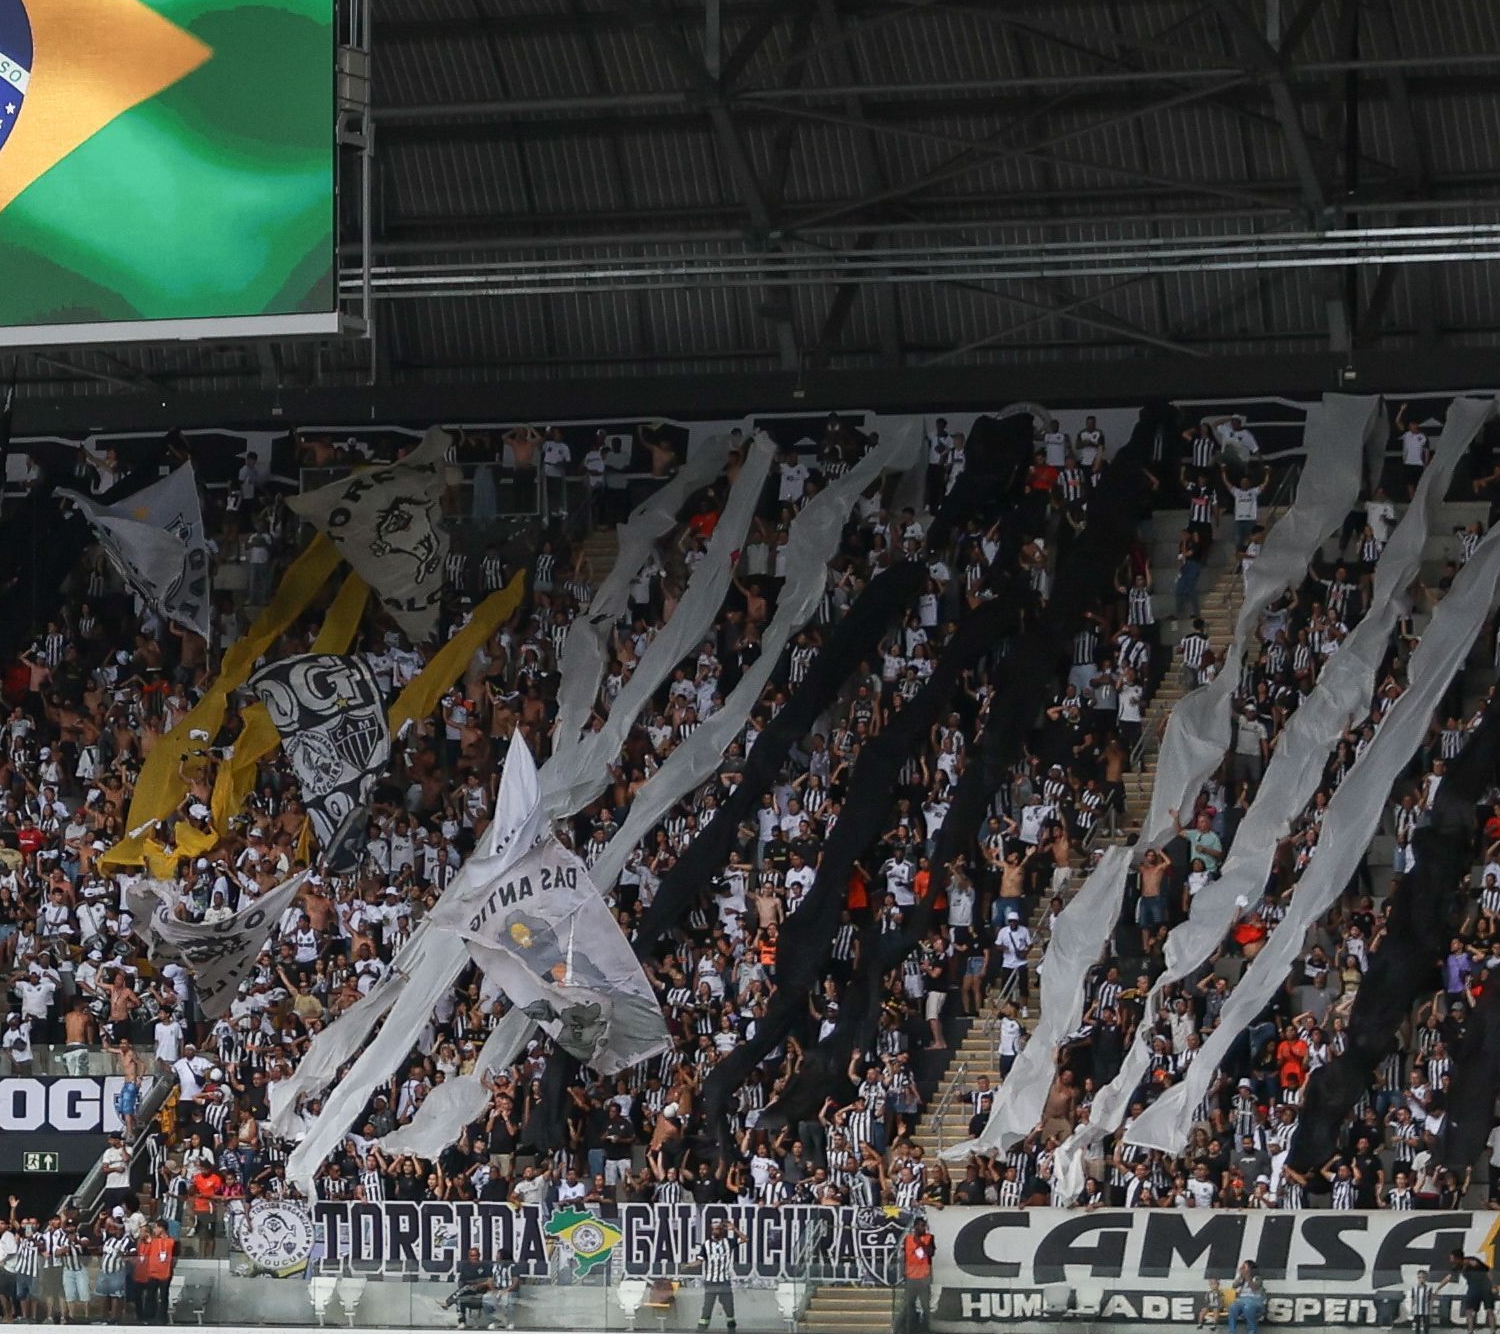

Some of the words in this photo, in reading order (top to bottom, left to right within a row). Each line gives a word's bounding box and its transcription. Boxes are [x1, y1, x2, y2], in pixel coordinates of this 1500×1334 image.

[336, 718, 372, 741] CAM
[313, 1204, 549, 1276] TORCIDA
[953, 1209, 1469, 1287] CAMISA
